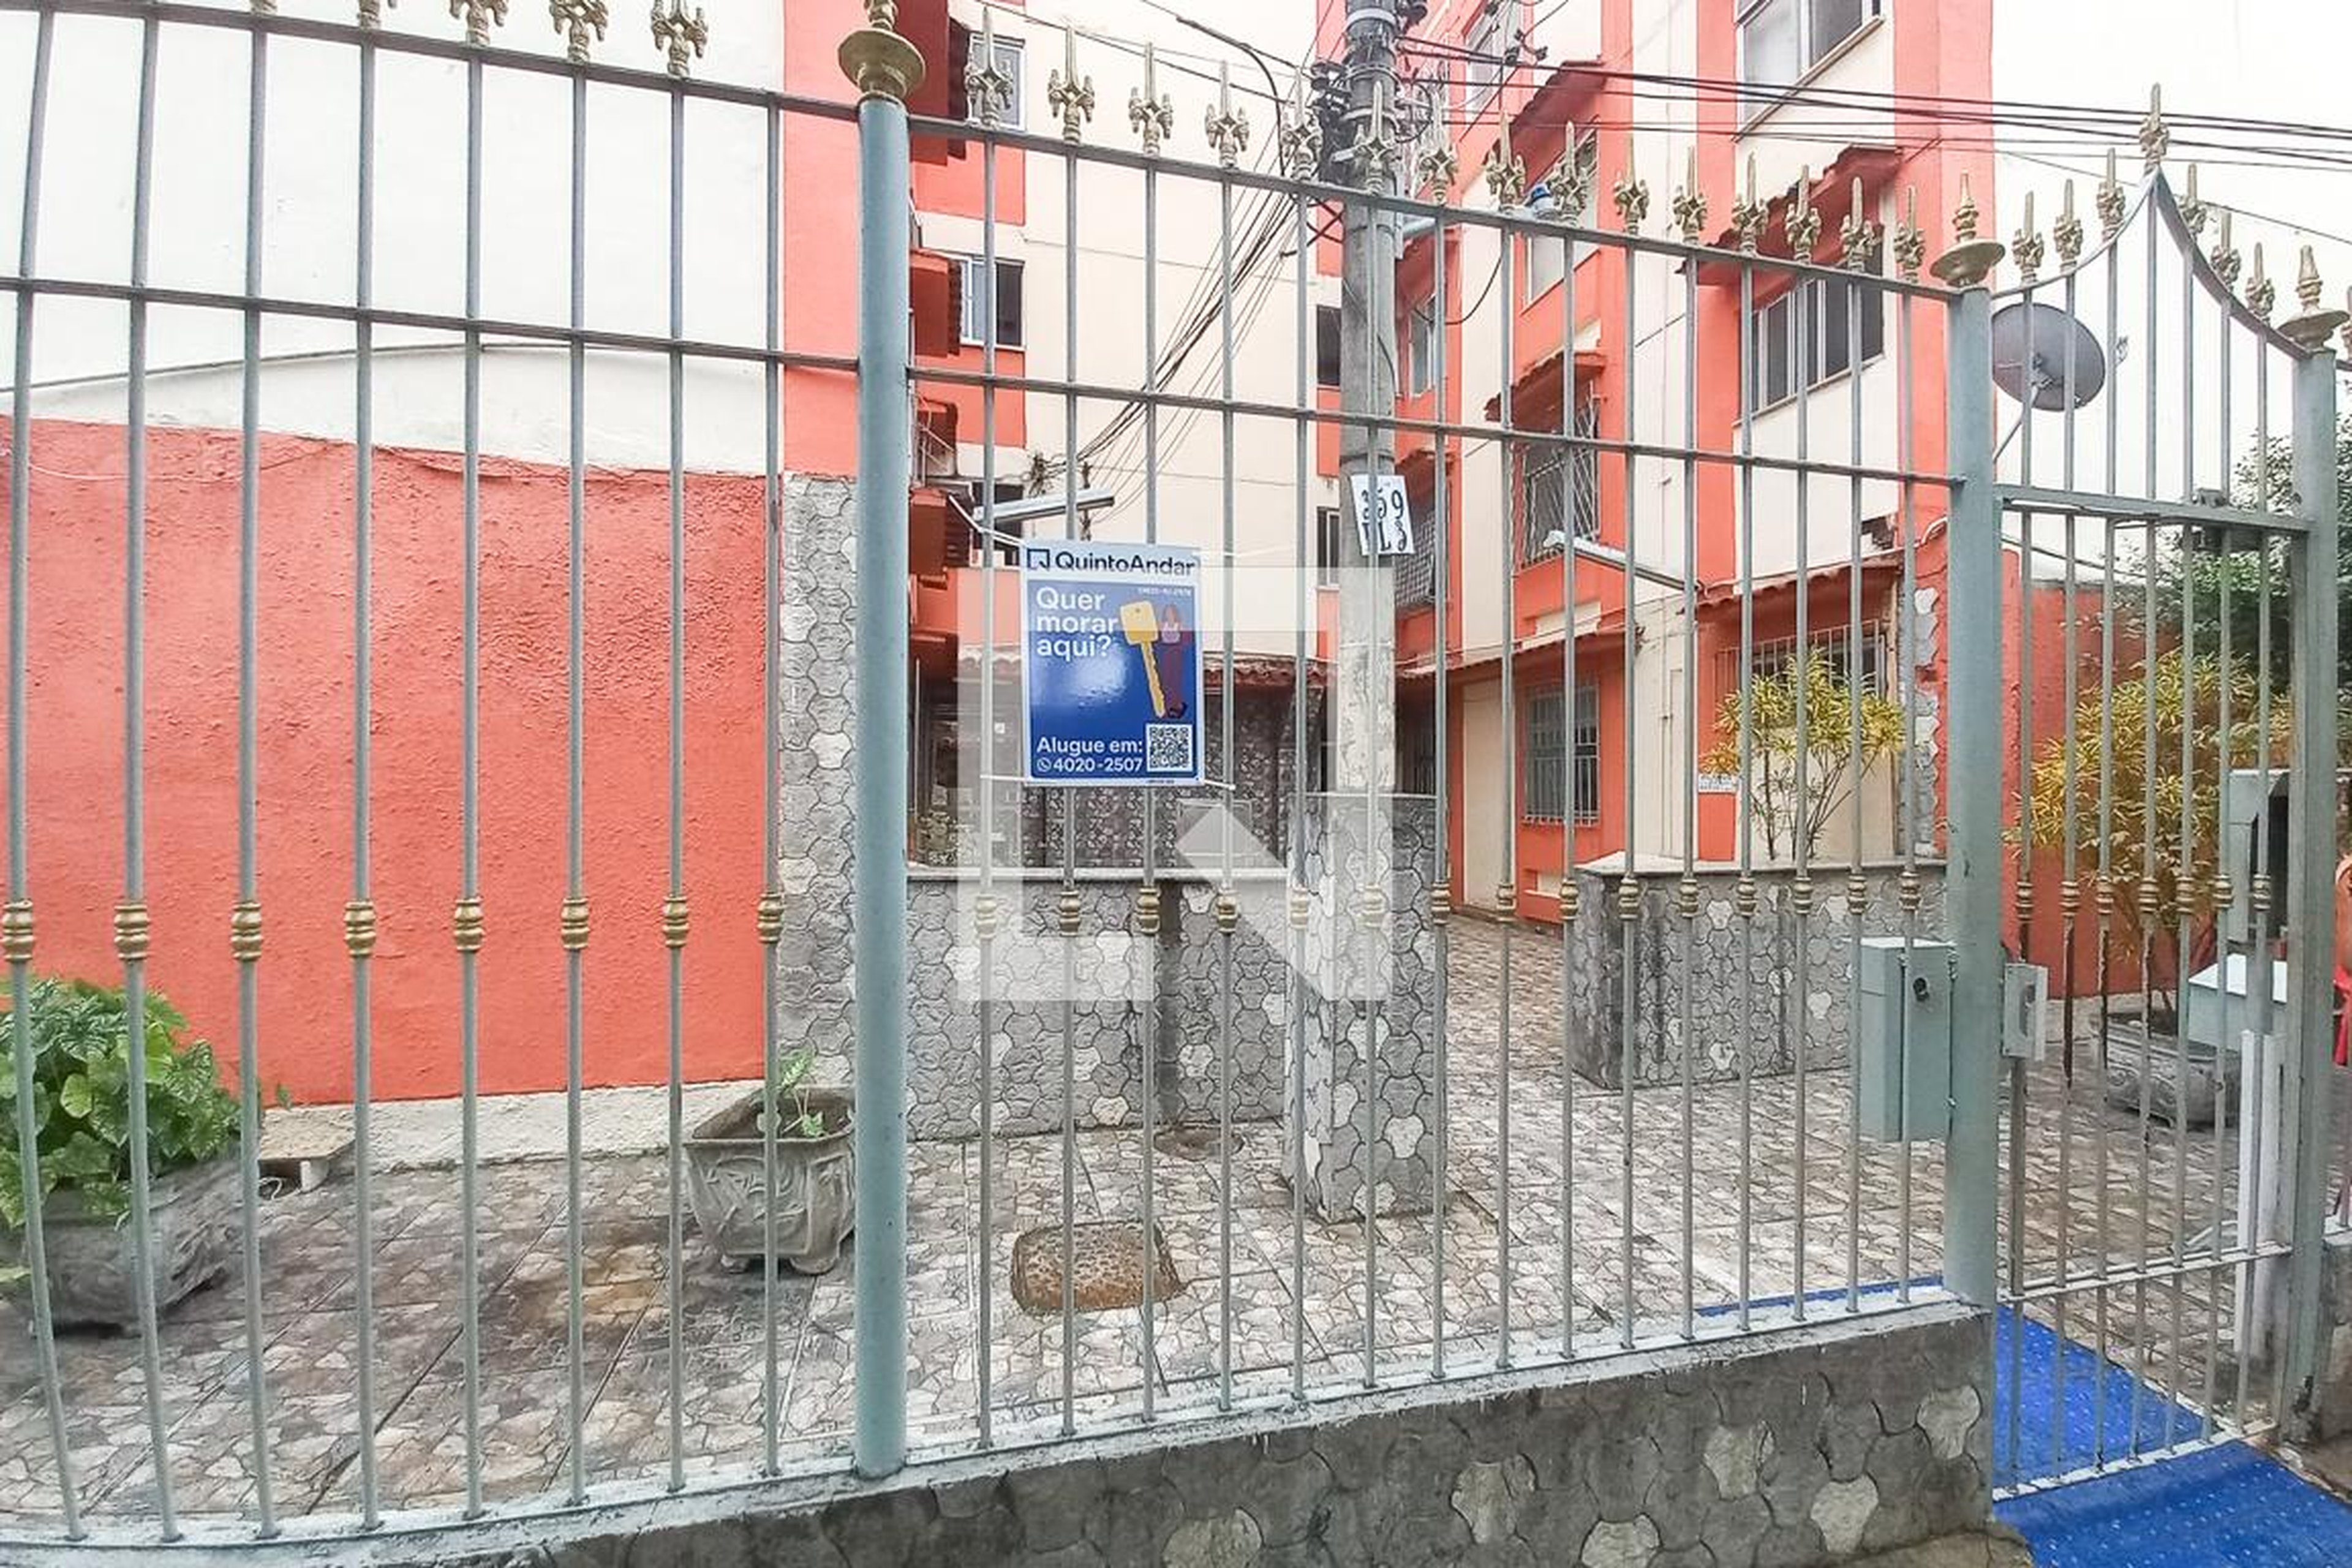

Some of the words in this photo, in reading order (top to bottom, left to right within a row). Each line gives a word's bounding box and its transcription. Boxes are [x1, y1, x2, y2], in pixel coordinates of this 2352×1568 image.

[1055, 552, 1195, 575] QuintoAndar
[1036, 587, 1105, 610] Quer
[1037, 616, 1117, 633] morar
[1037, 635, 1111, 661] aqui?
[1036, 737, 1105, 756] Alugue
[1109, 742, 1143, 753] em:
